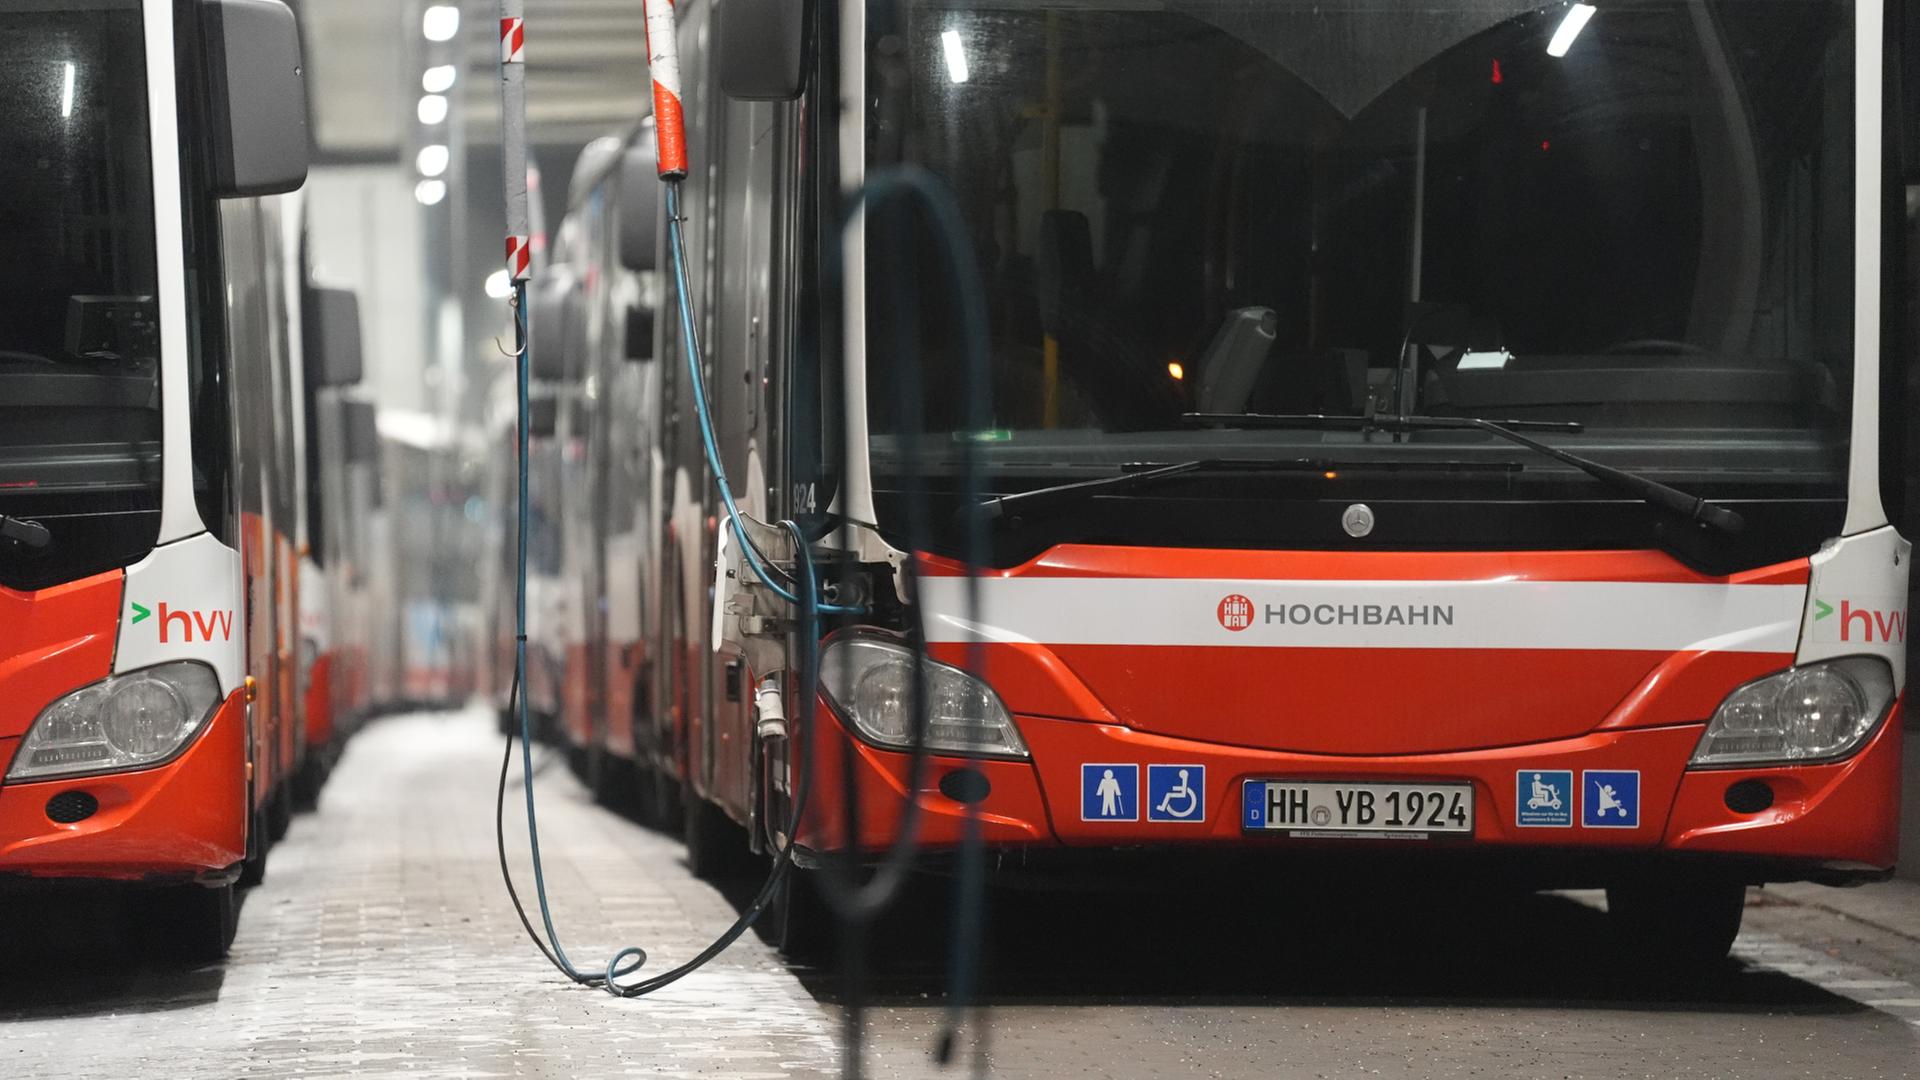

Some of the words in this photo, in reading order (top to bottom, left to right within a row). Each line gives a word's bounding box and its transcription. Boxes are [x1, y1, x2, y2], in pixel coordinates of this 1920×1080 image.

[158, 602, 233, 643] hvv
[1265, 603, 1454, 626] HOCHBAHN
[1250, 809, 1260, 821] D
[1267, 788, 1309, 824] HH
[1336, 789, 1376, 826] YB
[1385, 790, 1466, 827] 1924
